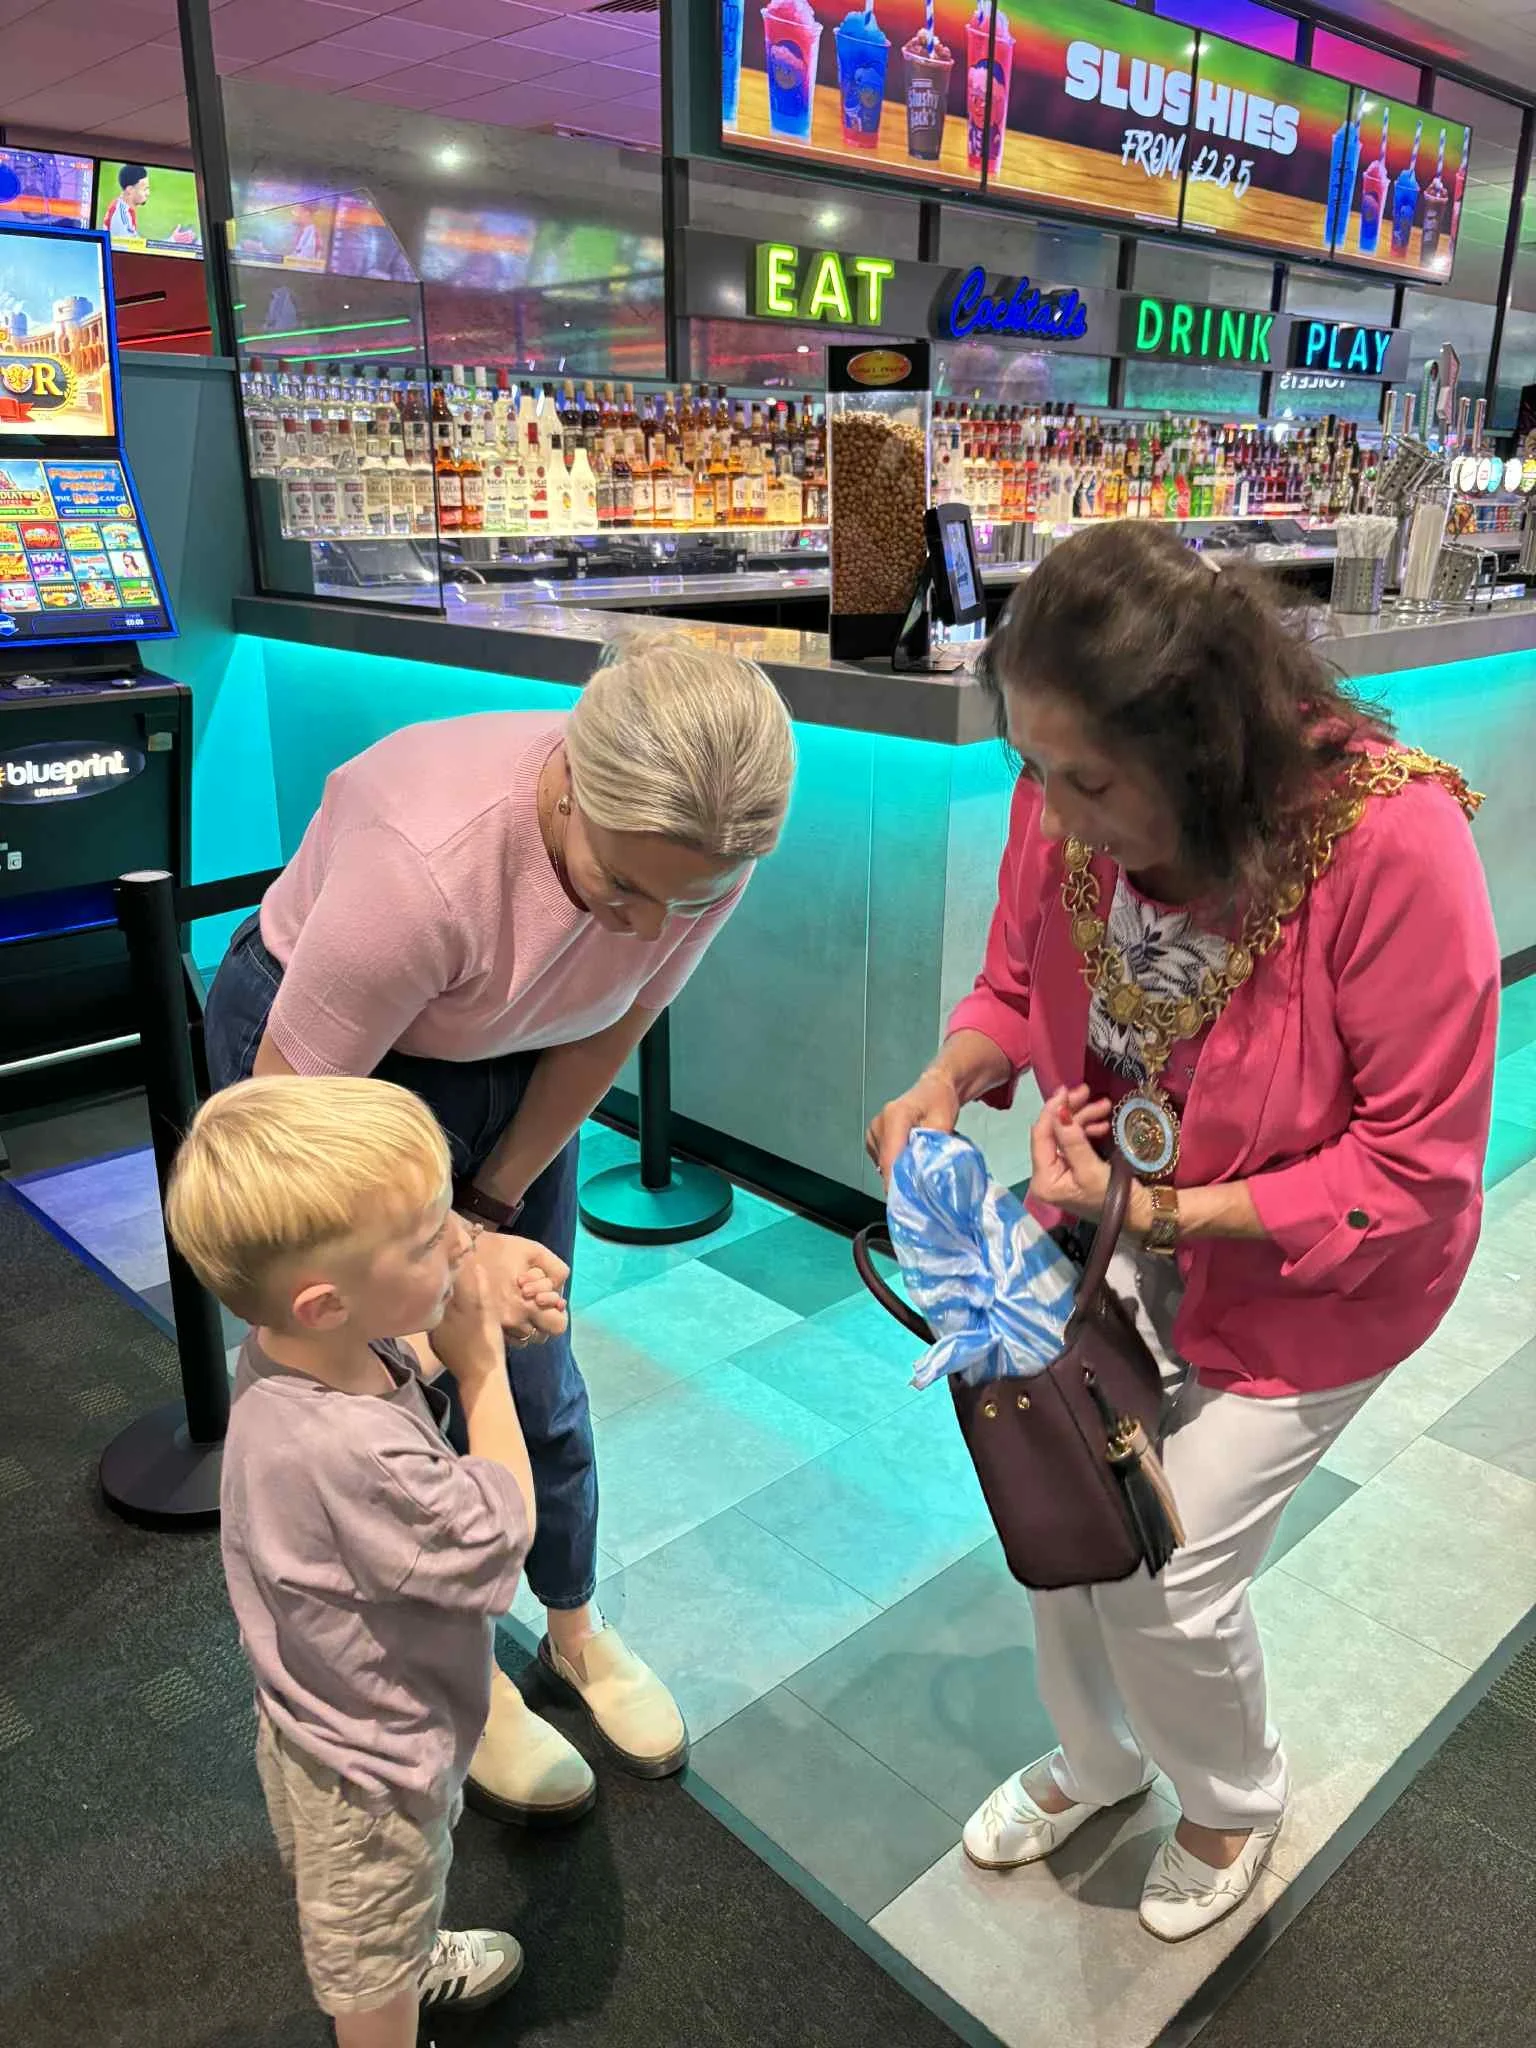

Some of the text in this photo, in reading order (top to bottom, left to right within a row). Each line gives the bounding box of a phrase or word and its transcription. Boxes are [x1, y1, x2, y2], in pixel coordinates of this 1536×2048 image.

[1065, 40, 1300, 156] SLUSHIES
[1121, 129, 1187, 181] FROM
[757, 242, 895, 326] EAT
[950, 265, 1089, 340] Cocktails
[1136, 298, 1275, 364] DRINK
[1305, 321, 1394, 376] PLAY
[7, 751, 130, 786] blueprint
